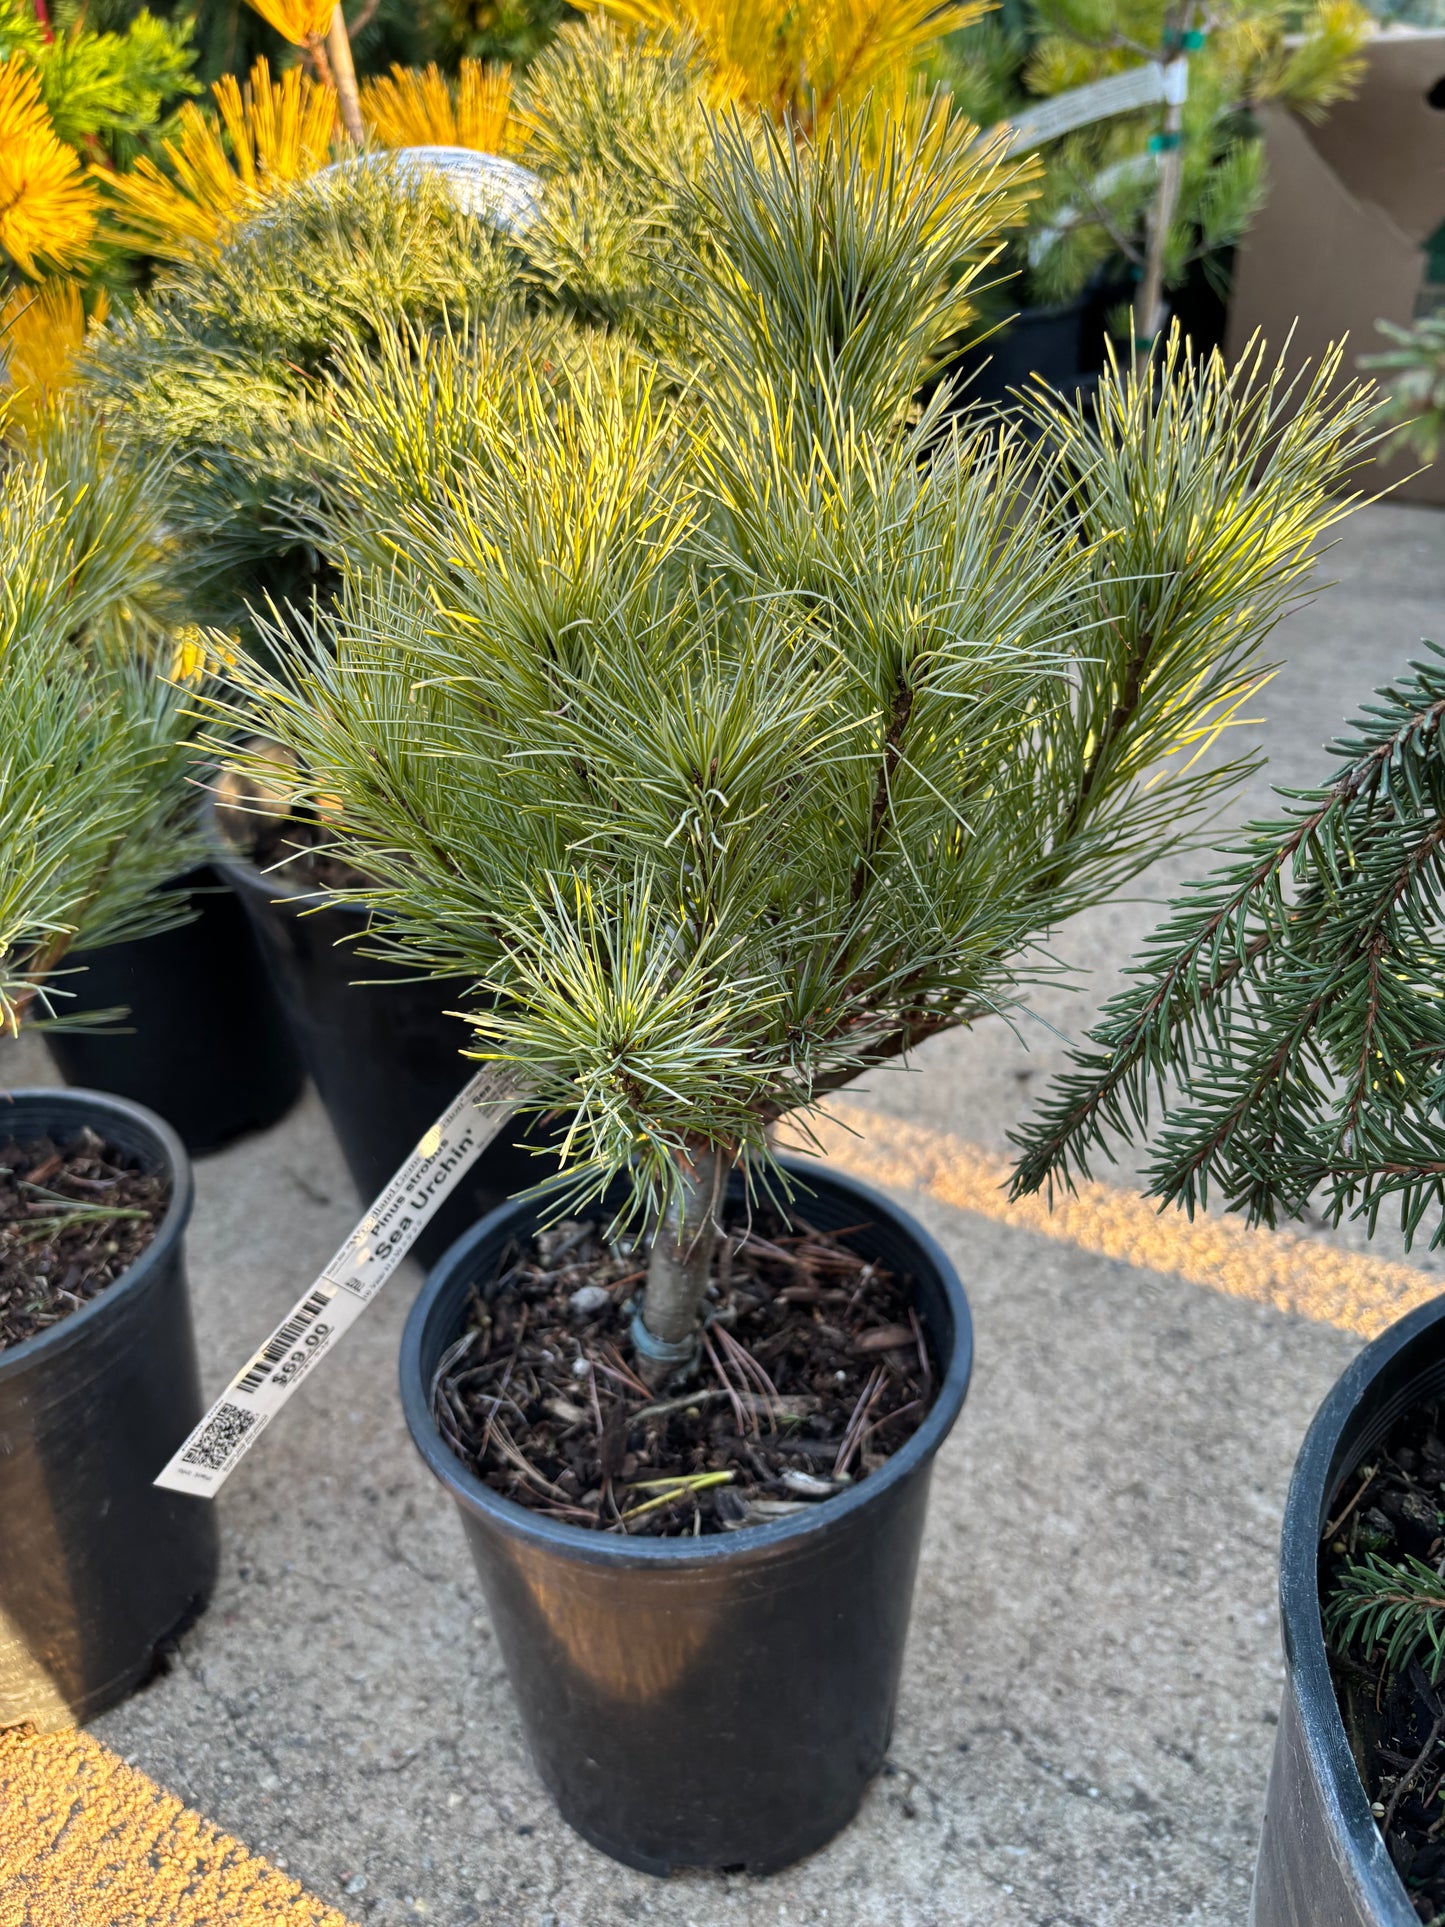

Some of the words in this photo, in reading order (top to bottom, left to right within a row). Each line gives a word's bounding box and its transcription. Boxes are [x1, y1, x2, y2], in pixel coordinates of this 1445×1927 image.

[368, 1216, 413, 1262] 'Sea
[411, 1127, 474, 1210] Urchin'
[370, 1196, 406, 1236] Pinus
[406, 1139, 449, 1192] strobus
[272, 1323, 329, 1386] $69.00
